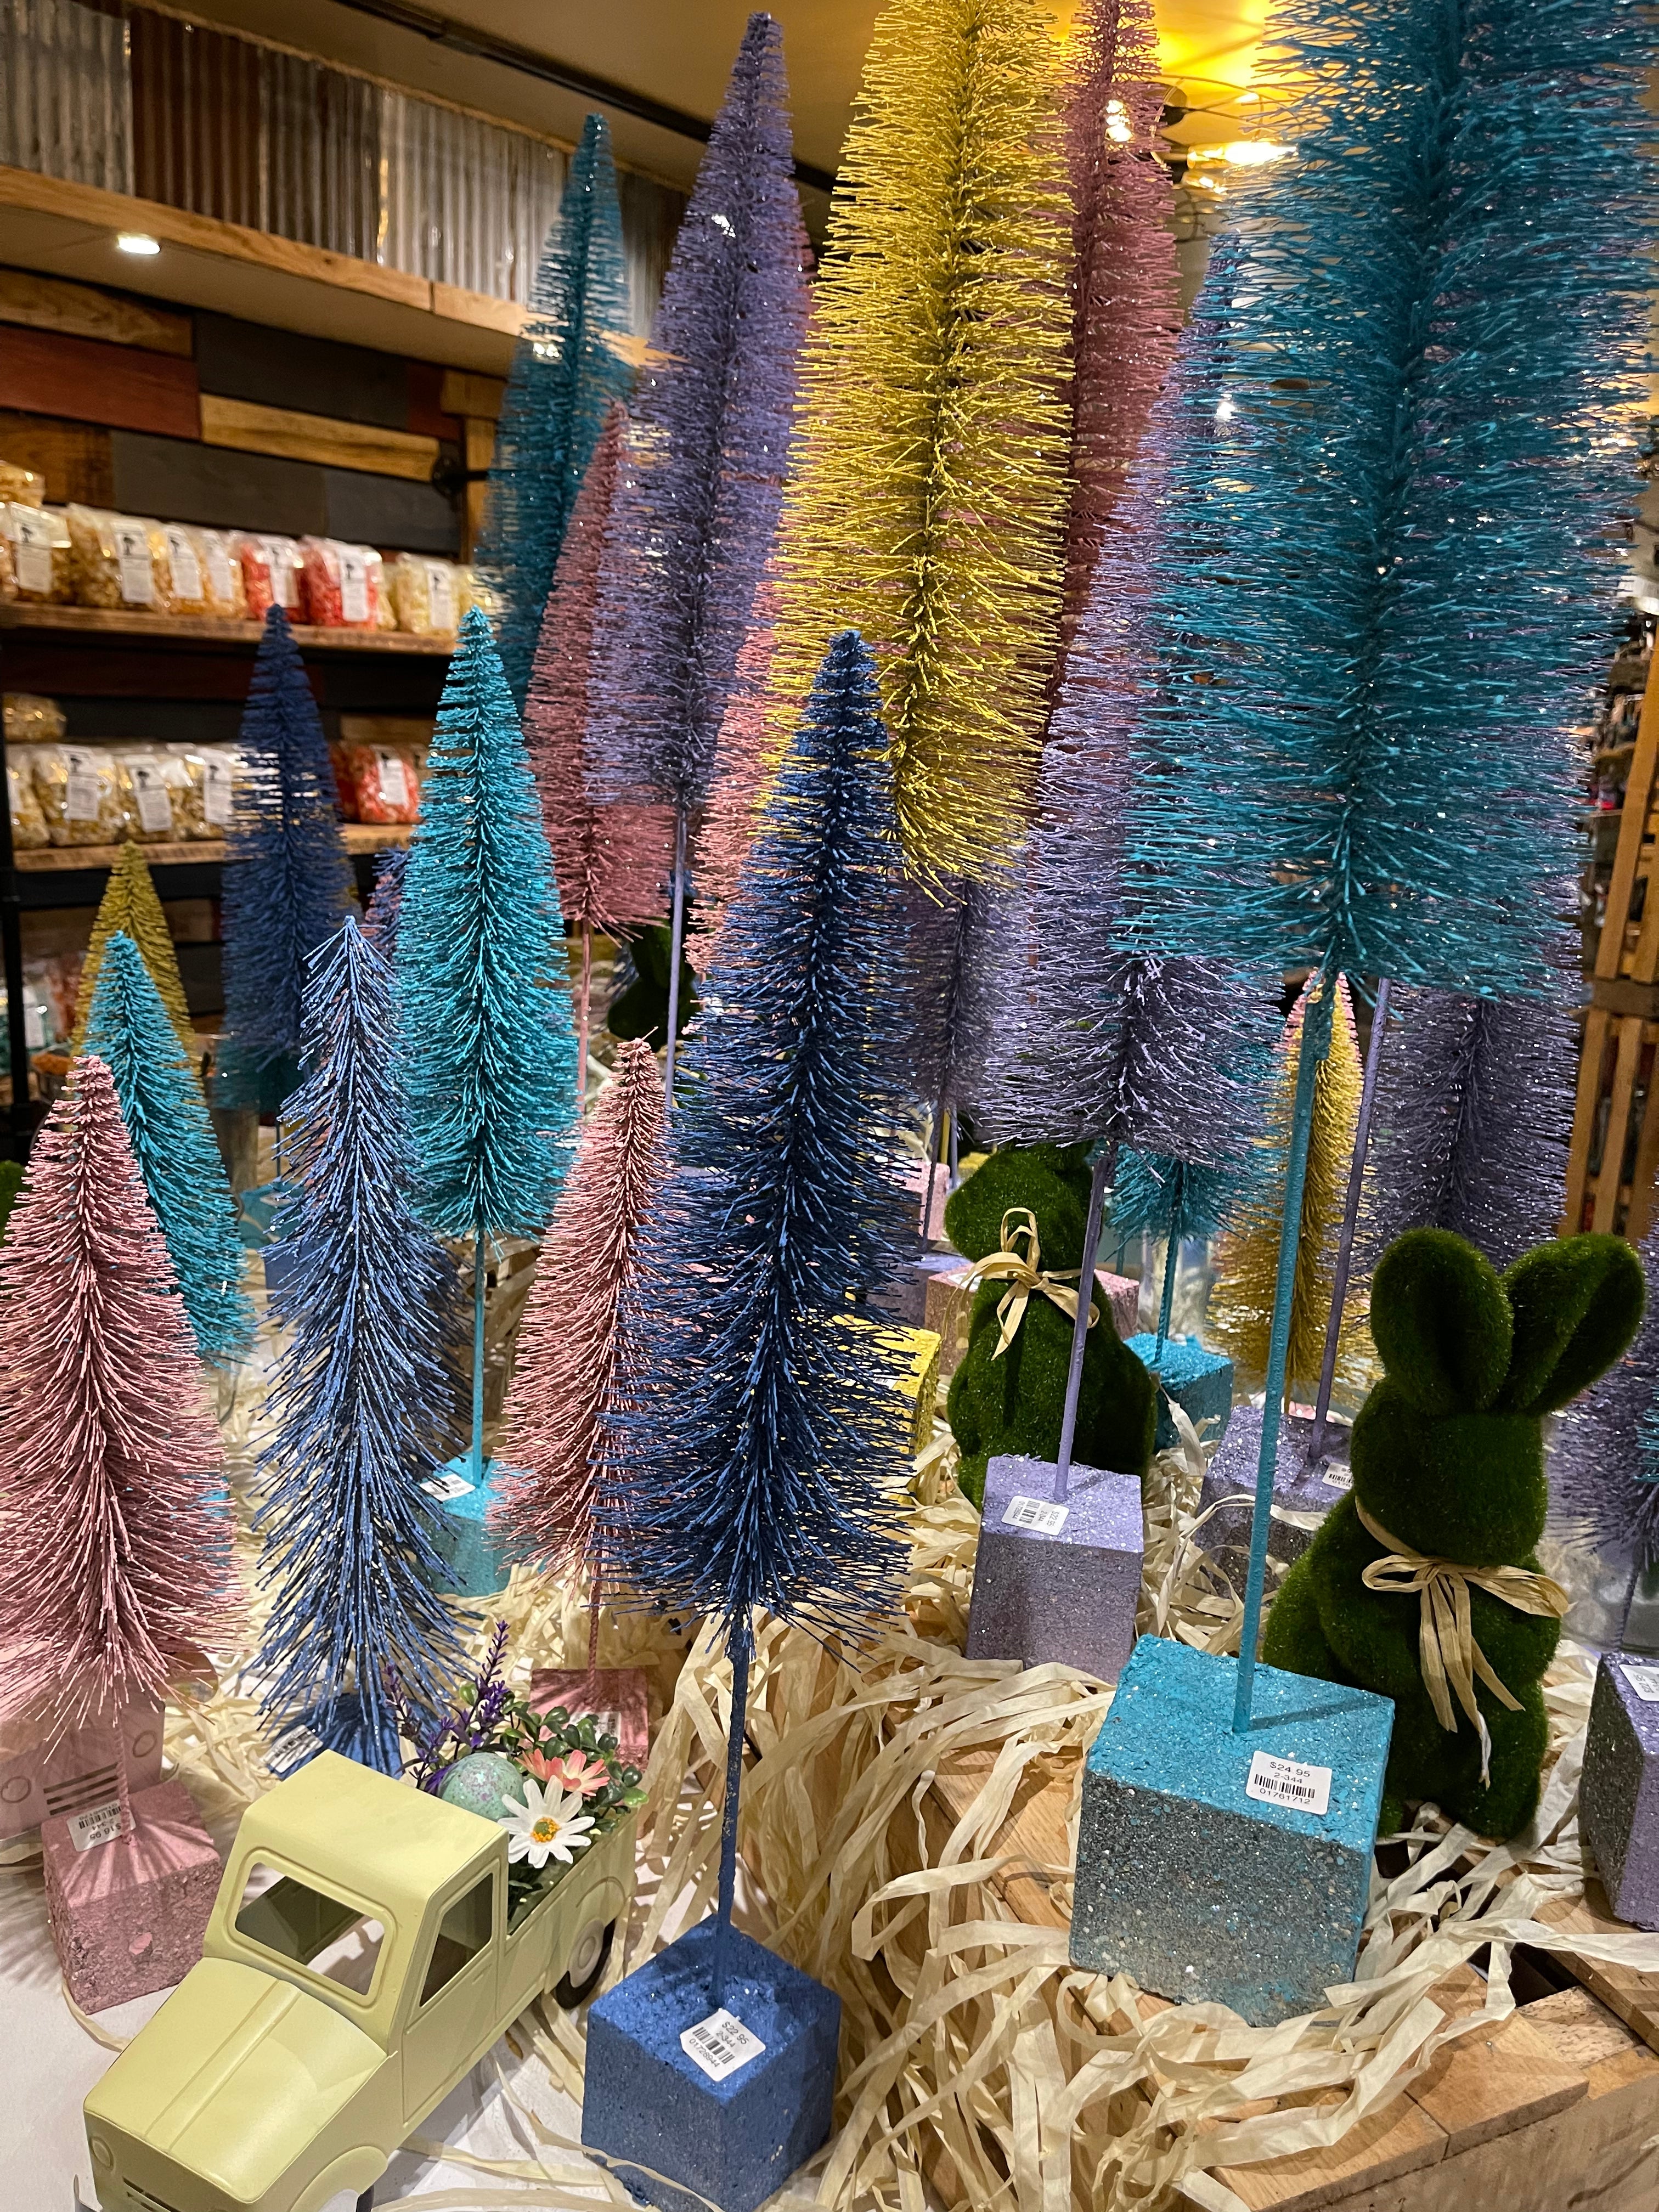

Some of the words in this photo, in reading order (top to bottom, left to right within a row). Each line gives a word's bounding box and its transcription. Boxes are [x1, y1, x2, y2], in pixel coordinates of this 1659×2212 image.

[1274, 1772, 1303, 1784] 2-344
[1260, 1788, 1311, 1804] 01761712
[721, 2021, 749, 2045] $2295
